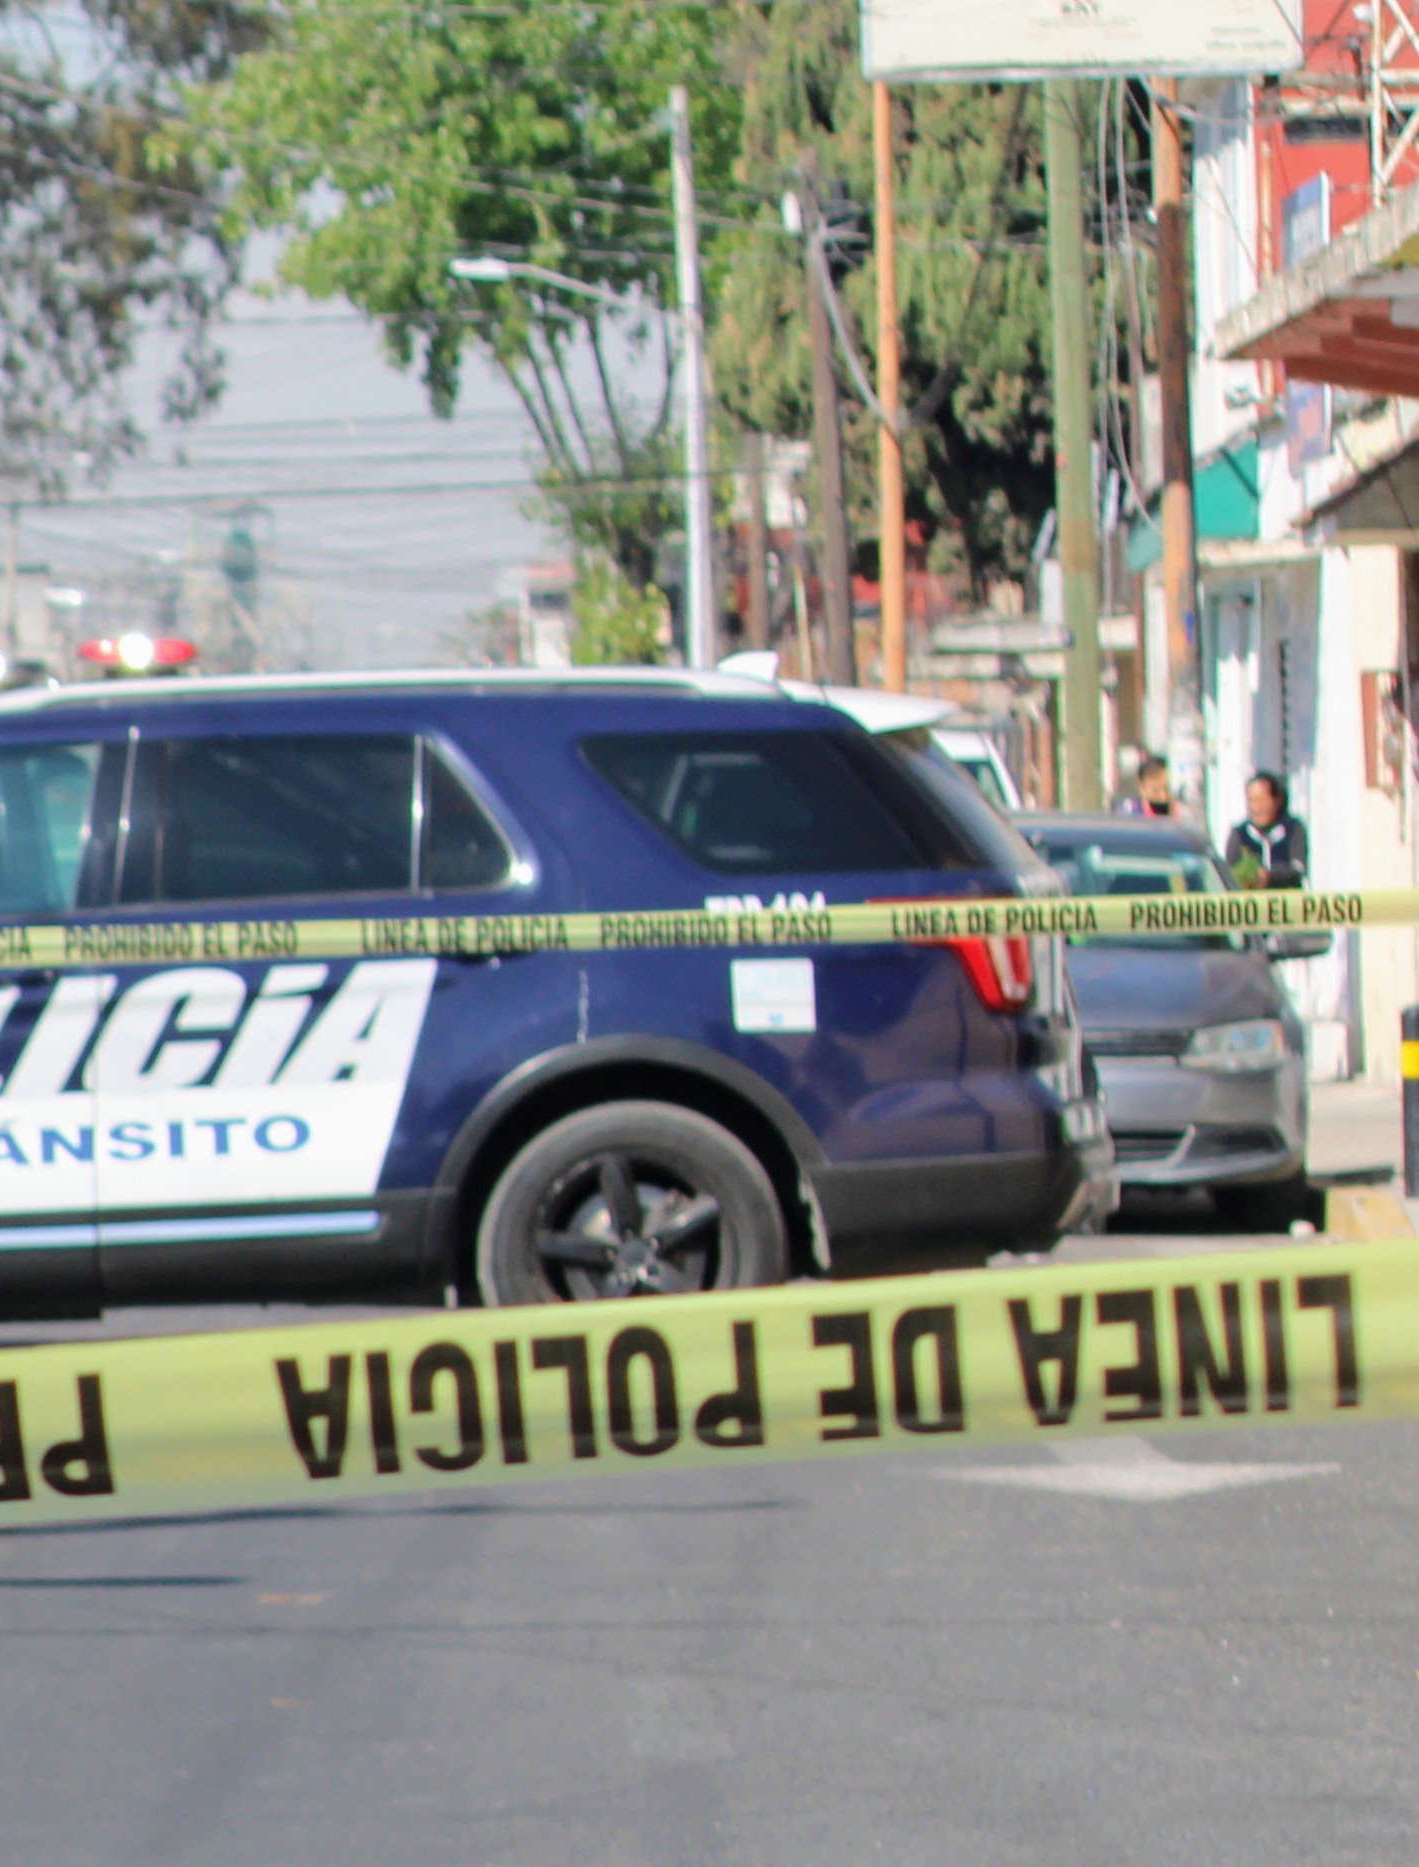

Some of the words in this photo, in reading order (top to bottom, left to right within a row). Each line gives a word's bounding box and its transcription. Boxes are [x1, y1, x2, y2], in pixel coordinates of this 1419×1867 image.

[64, 926, 193, 957] PROHIBIDO
[203, 924, 229, 956] EL
[238, 923, 298, 954] PASO
[361, 920, 428, 952] LINEA
[437, 919, 466, 950] DE
[477, 917, 568, 949] POLICIA
[601, 913, 728, 946] PROHIBIDO
[738, 912, 759, 943] EL
[772, 911, 832, 942] PASO
[892, 908, 959, 937] LINEA
[968, 906, 996, 933] DE
[1006, 902, 1098, 932] POLICIA
[1130, 897, 1259, 928] PROHIBIDO
[1269, 896, 1293, 925] EL
[1302, 893, 1362, 924] PASO
[292, 1319, 764, 1480] POLICIA
[812, 1305, 965, 1441] DE
[1008, 1273, 1360, 1426] LINEA
